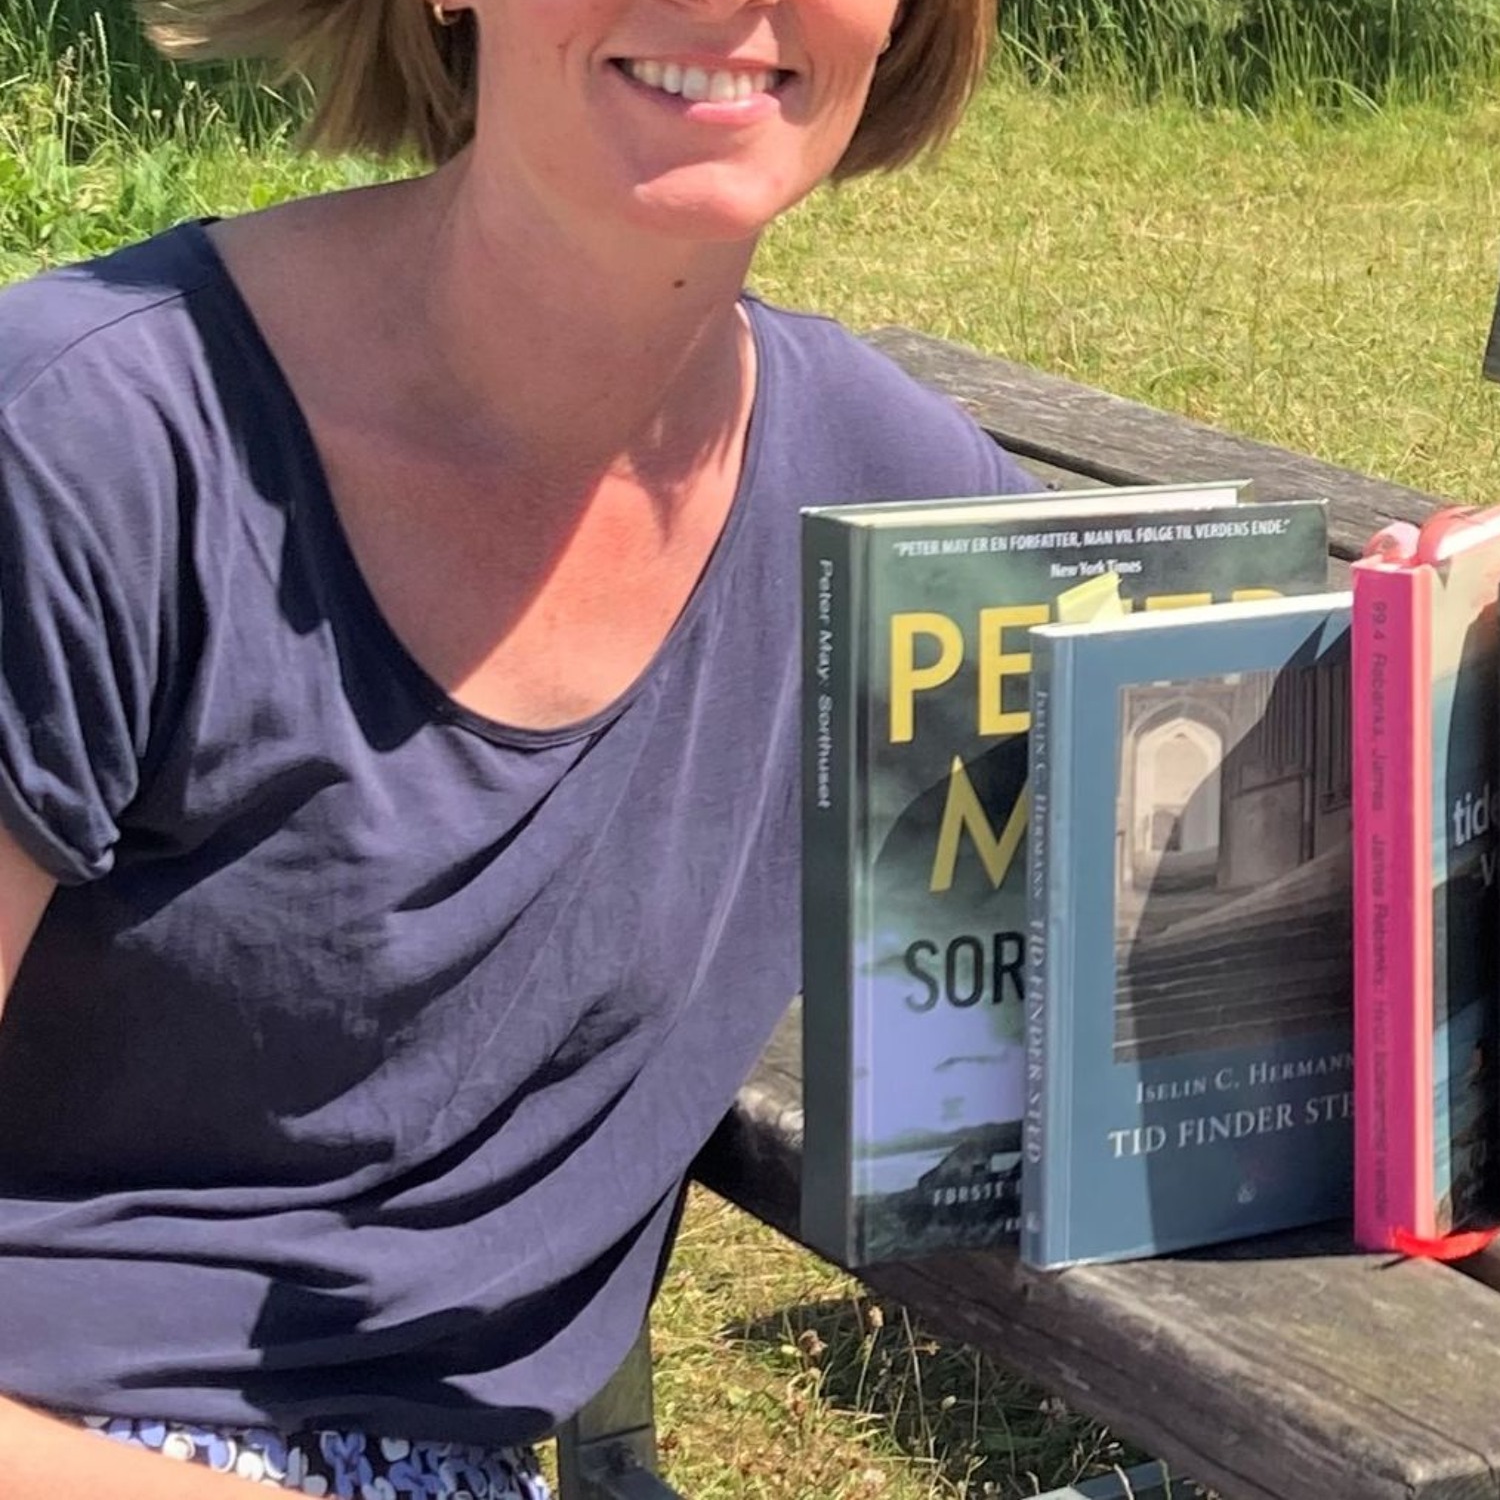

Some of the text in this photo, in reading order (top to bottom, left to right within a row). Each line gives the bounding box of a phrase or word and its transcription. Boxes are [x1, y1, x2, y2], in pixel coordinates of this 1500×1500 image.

[942, 538, 971, 554] MAY
[972, 537, 989, 553] ER
[991, 536, 1008, 552] EN
[1010, 532, 1082, 551] FORFATTER,
[1084, 529, 1113, 546] MAN
[1115, 528, 1133, 544] VIL
[1136, 526, 1173, 542] FØLGE
[1175, 524, 1193, 540] TIL
[1195, 521, 1249, 538] VERDENS
[819, 559, 833, 625] Peter
[1050, 558, 1142, 578] New York Times
[818, 694, 833, 808] Sorthuset
[904, 931, 1027, 1014] SOR
[1135, 1075, 1207, 1104] ISELIN
[1214, 1068, 1240, 1092] C.
[1108, 1125, 1167, 1159] TID
[1178, 1103, 1294, 1148] FINDER
